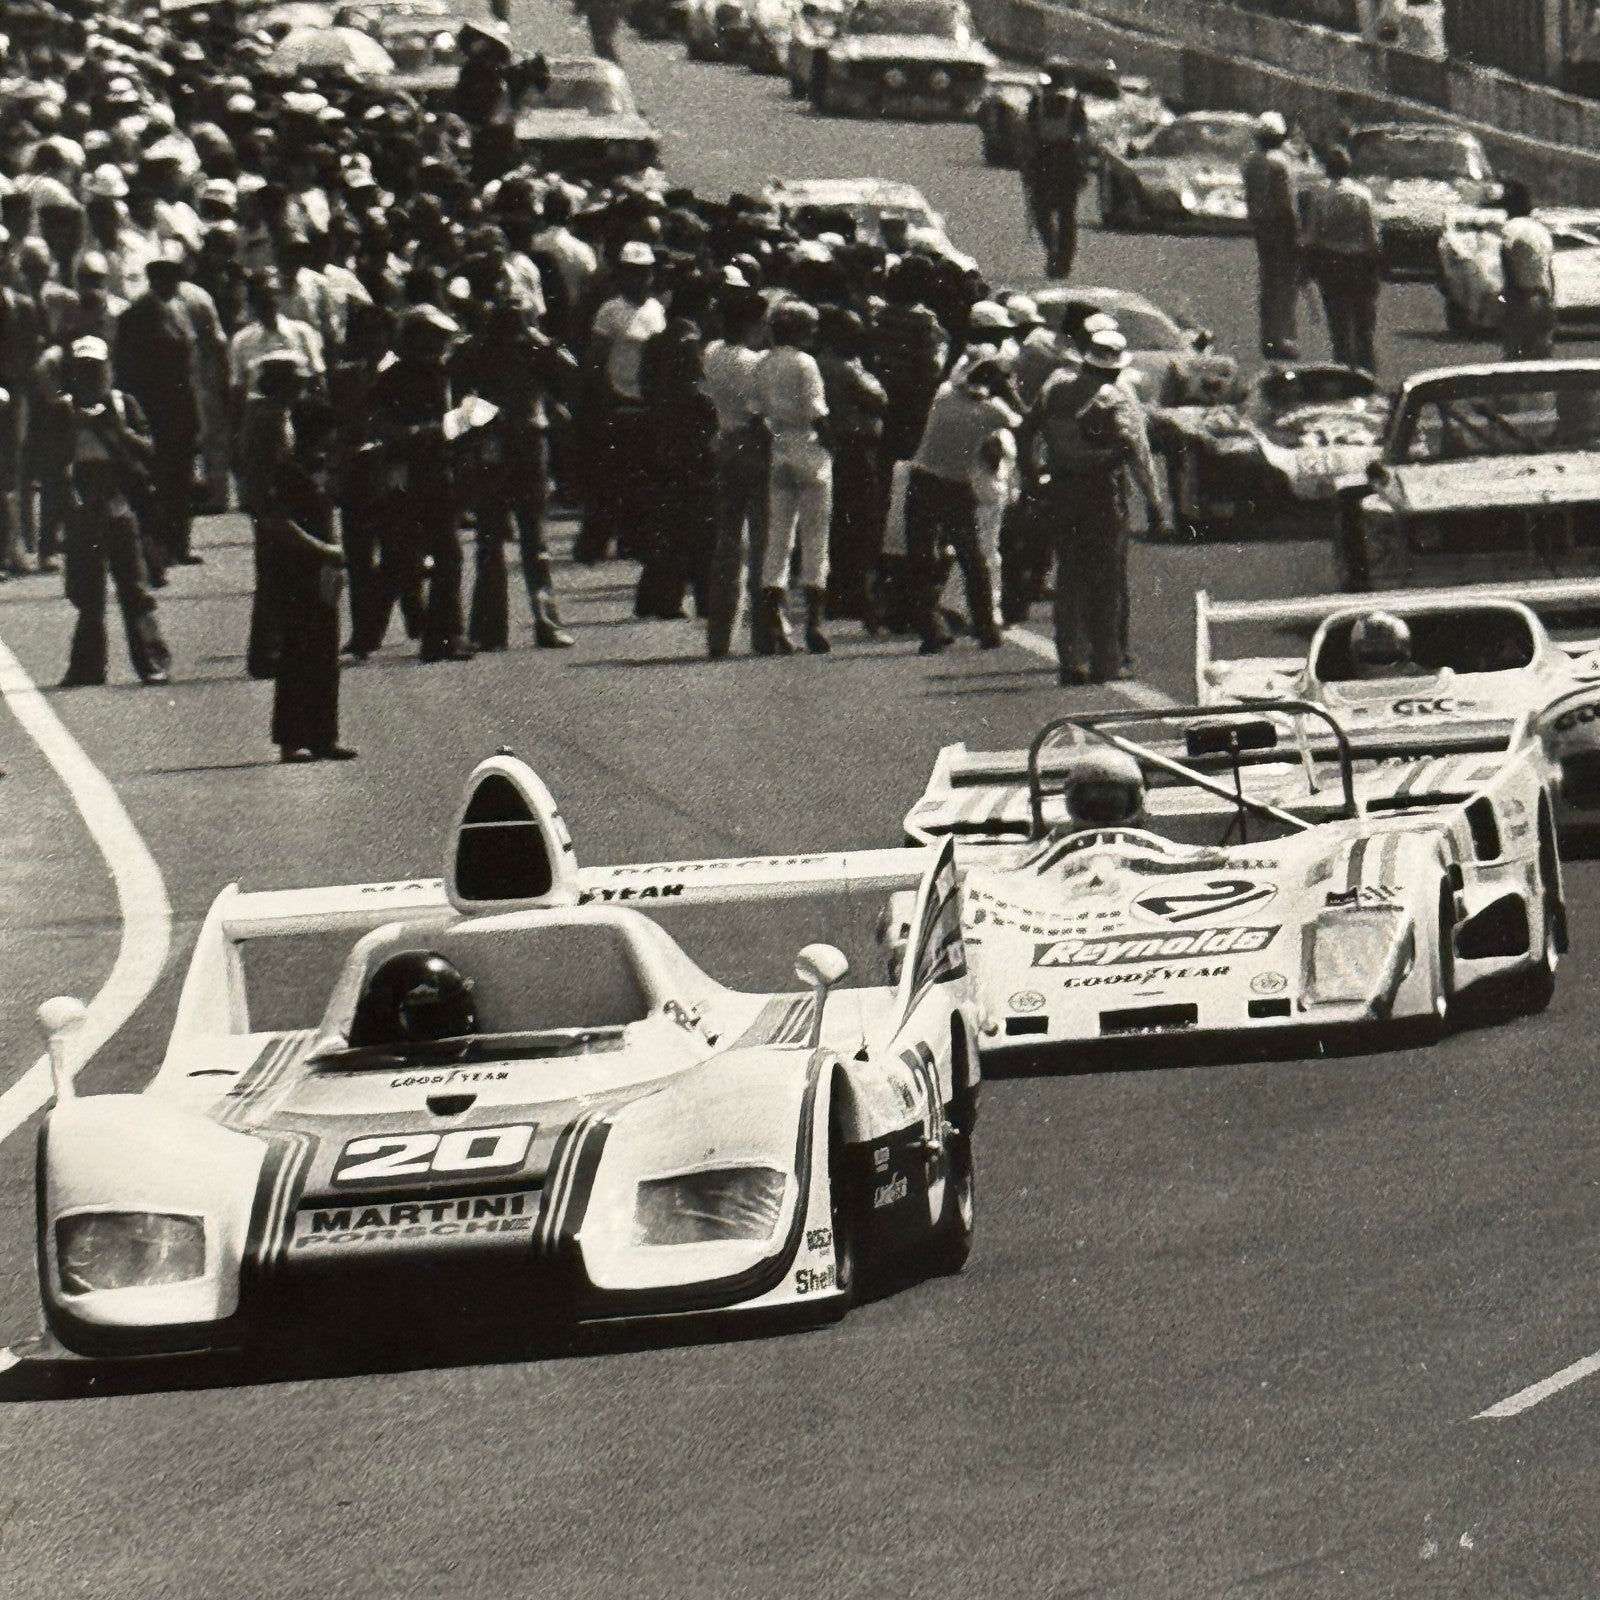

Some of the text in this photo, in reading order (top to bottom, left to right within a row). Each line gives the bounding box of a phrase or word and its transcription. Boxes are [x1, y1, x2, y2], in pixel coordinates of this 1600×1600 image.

[1037, 927, 1270, 967] Reynolds
[337, 1125, 534, 1181] 20
[296, 1216, 533, 1248] PORSCHE
[311, 1194, 525, 1234] MARTINI
